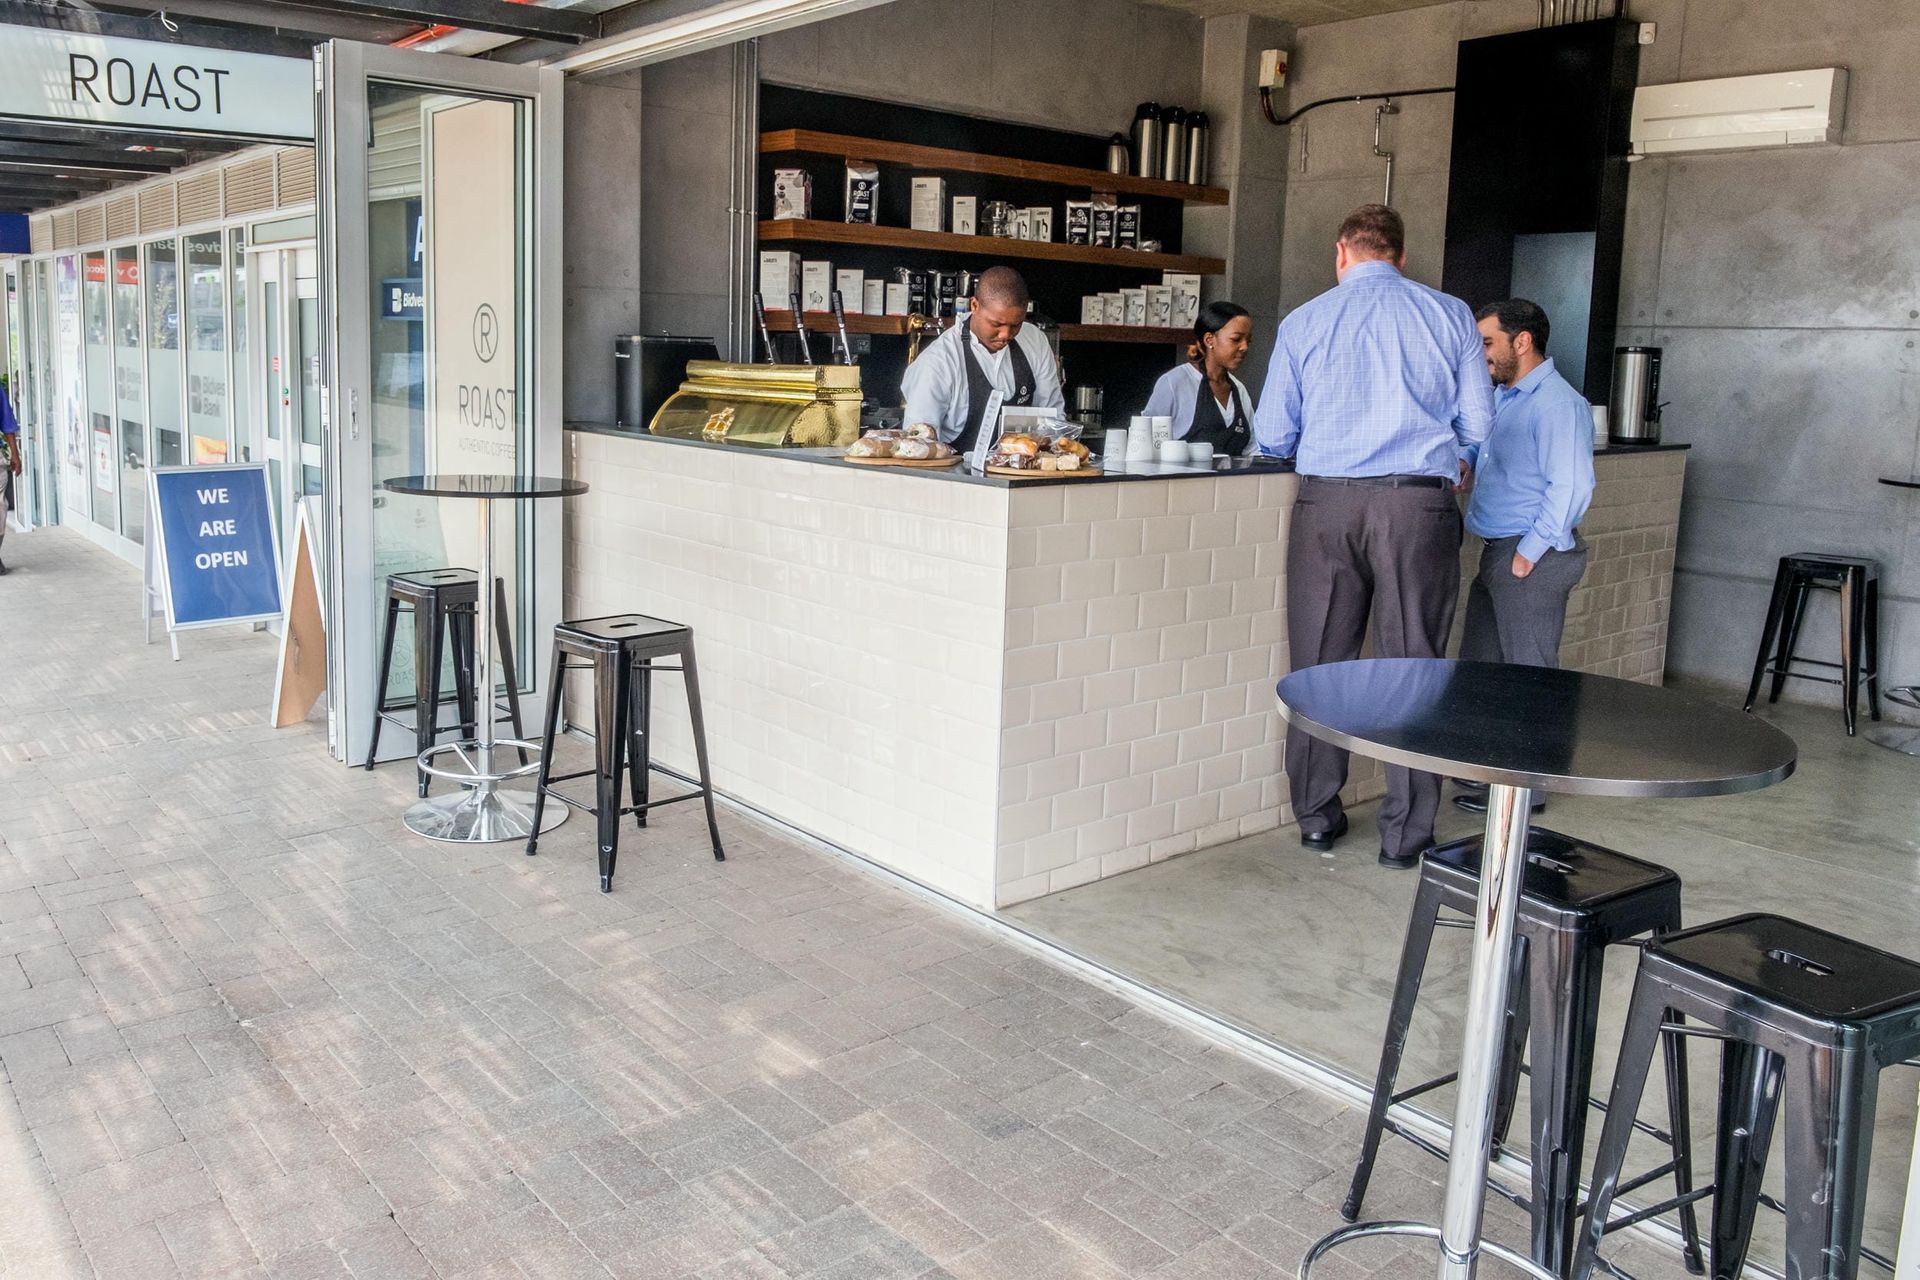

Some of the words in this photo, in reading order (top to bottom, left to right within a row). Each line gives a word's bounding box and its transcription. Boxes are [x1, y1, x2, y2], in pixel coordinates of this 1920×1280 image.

[69, 53, 230, 114] ROAST
[459, 384, 516, 432] ROAST
[196, 488, 230, 505] WE
[199, 519, 237, 537] ARE
[195, 550, 248, 570] OPEN
